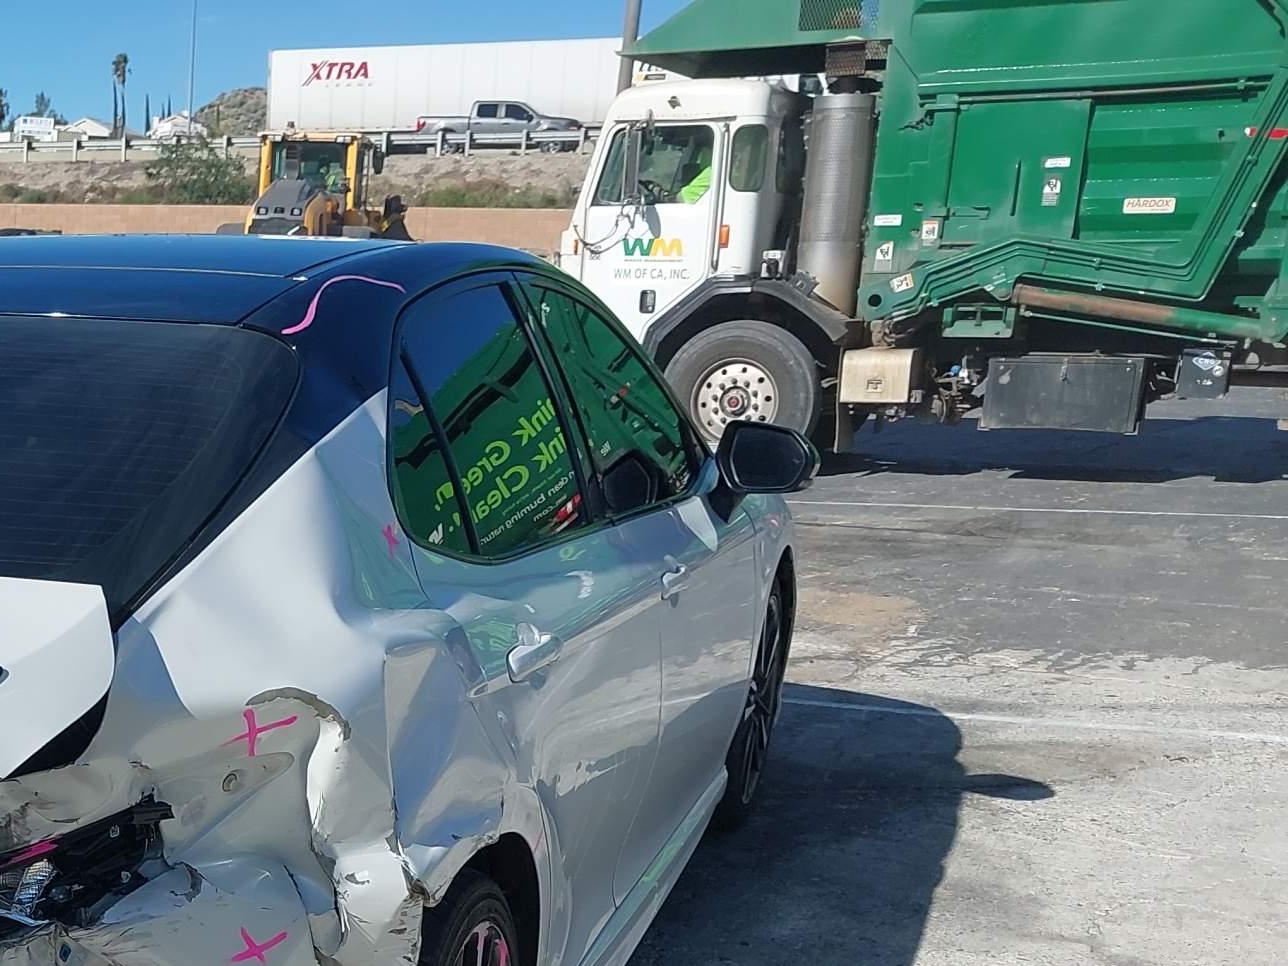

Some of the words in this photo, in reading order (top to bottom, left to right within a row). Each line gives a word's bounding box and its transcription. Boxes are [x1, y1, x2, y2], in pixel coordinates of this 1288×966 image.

[306, 60, 369, 81] XTRA
[1126, 199, 1172, 208] HARDOX
[623, 238, 683, 256] WM
[614, 268, 632, 279] WM
[634, 268, 648, 279] OF
[650, 269, 667, 280] CA,
[669, 269, 691, 279] INC.
